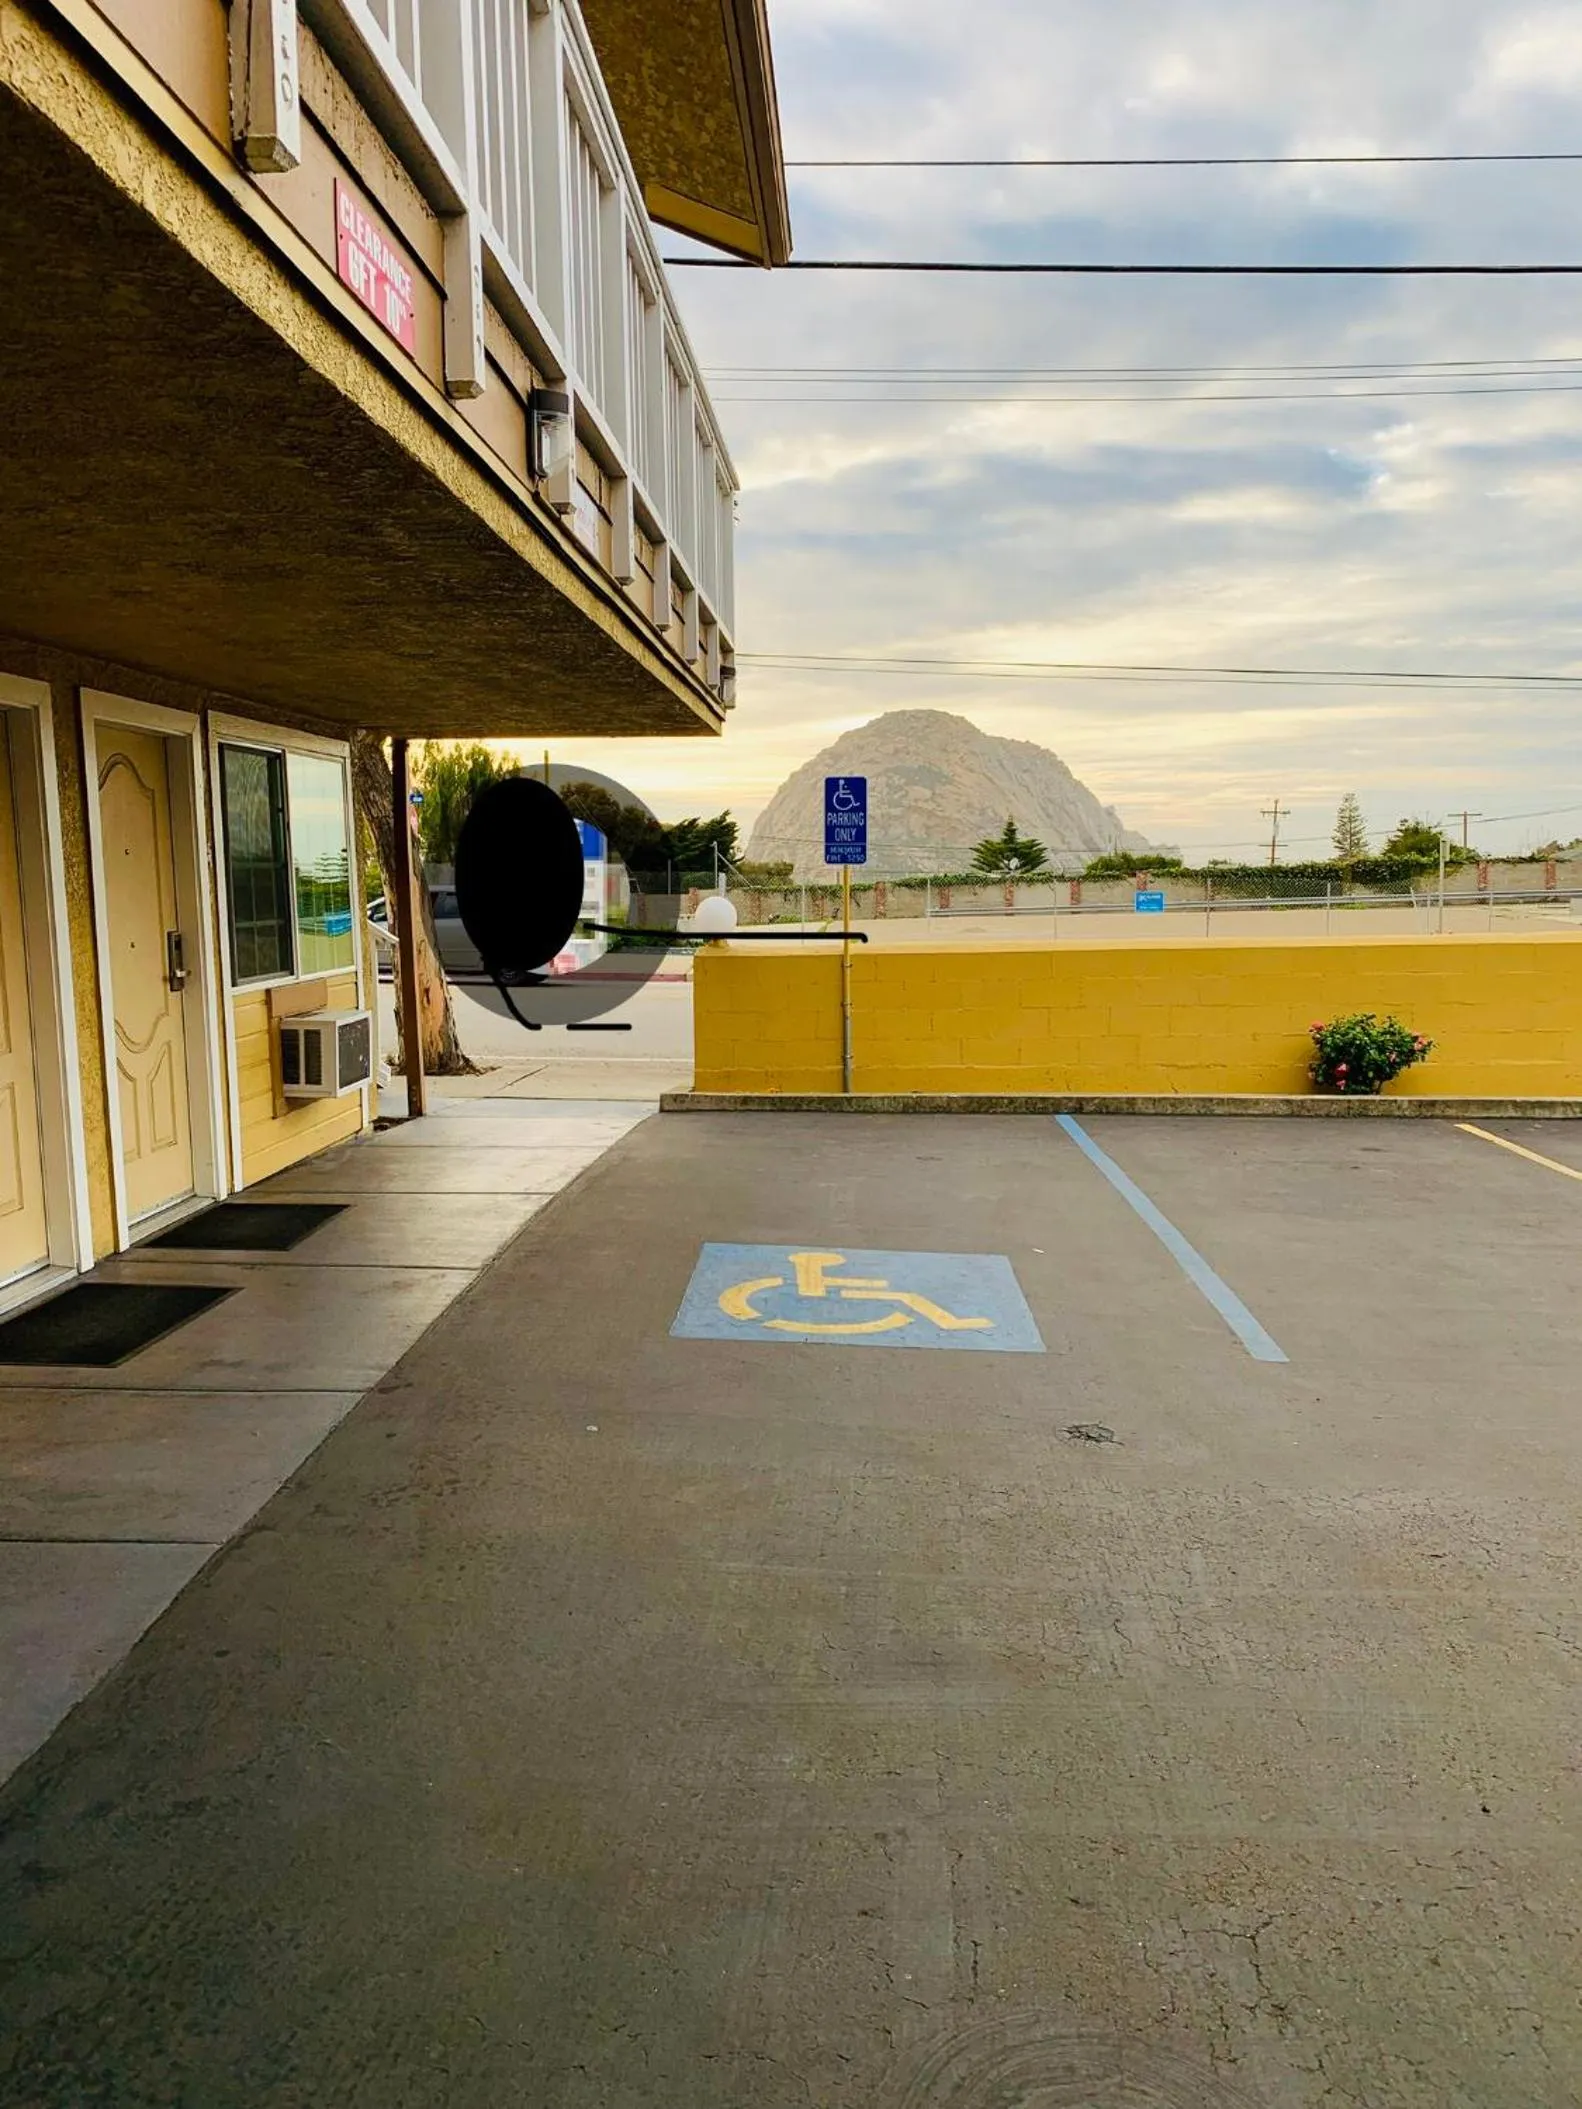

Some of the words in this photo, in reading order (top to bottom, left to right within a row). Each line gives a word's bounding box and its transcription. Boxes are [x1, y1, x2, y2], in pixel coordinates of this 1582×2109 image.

[339, 192, 411, 306] CLEARANCE
[349, 240, 376, 309] 6FT
[827, 812, 864, 826] PARKING
[835, 828, 857, 841] ONLY
